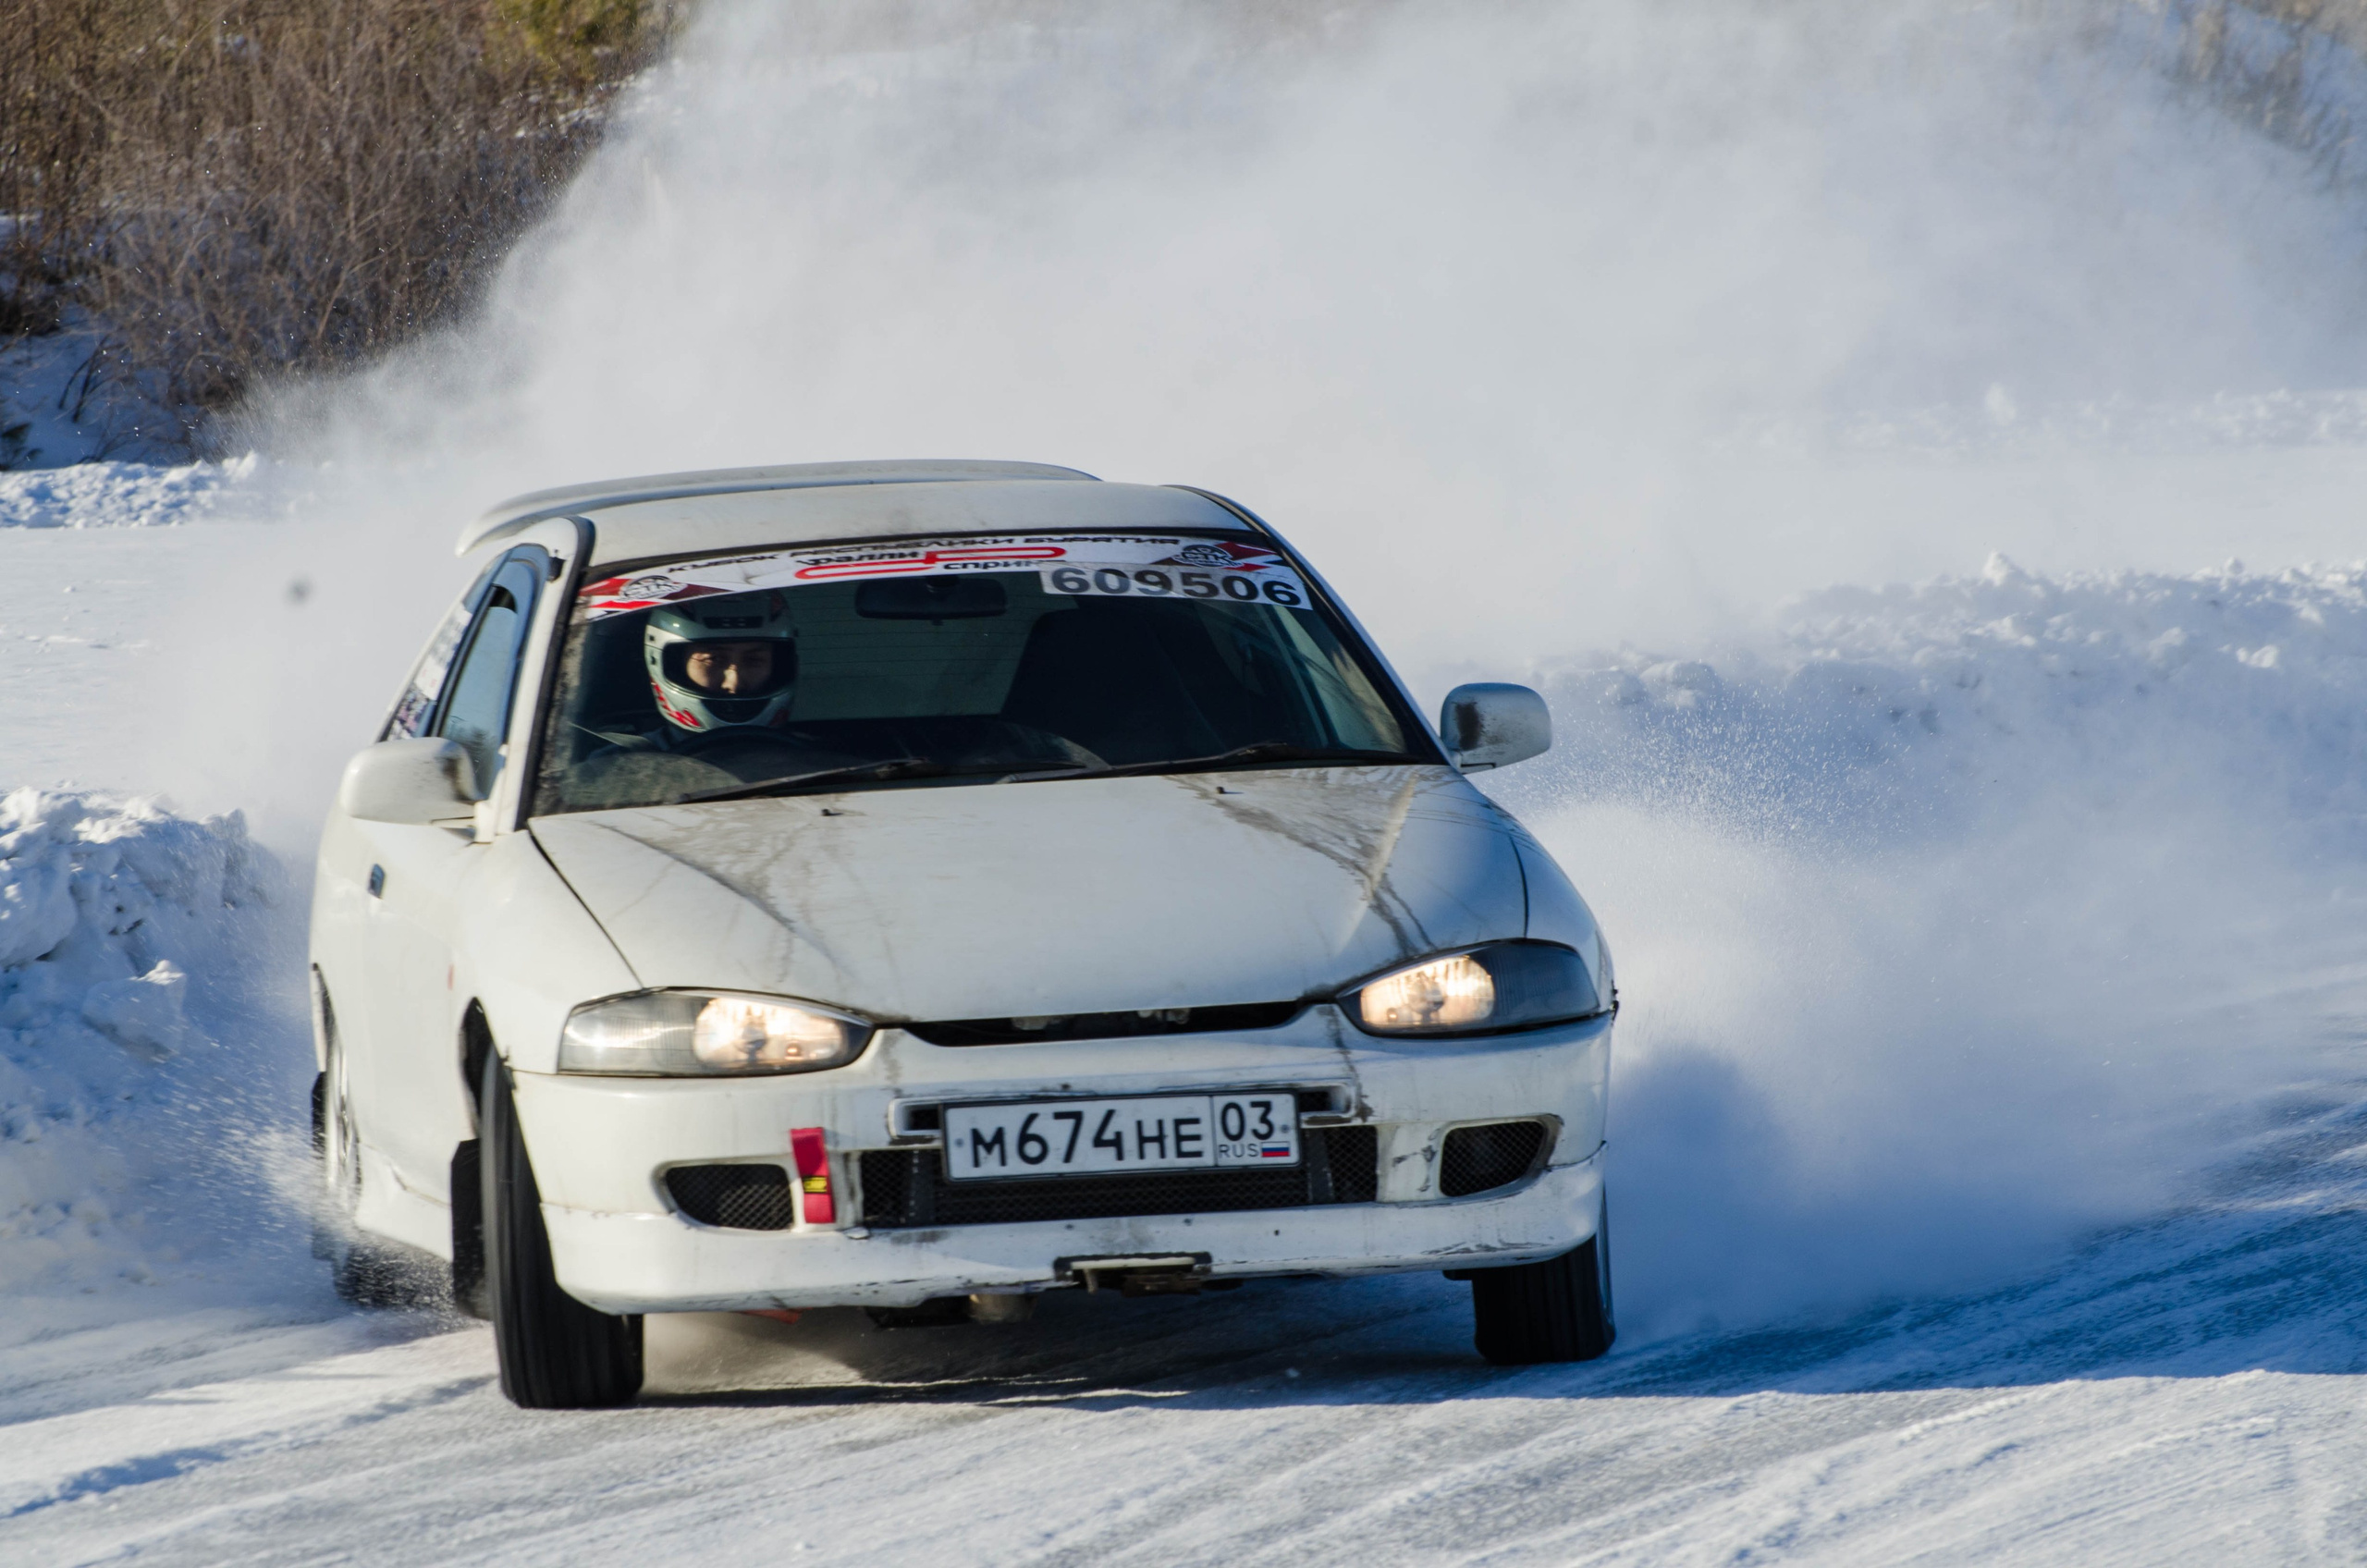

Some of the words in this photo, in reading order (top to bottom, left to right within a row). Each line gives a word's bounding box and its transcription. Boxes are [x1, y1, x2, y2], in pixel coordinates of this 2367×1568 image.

[1051, 567, 1302, 606] 609506
[1220, 1100, 1275, 1141] 03
[1220, 1144, 1259, 1159] RUS
